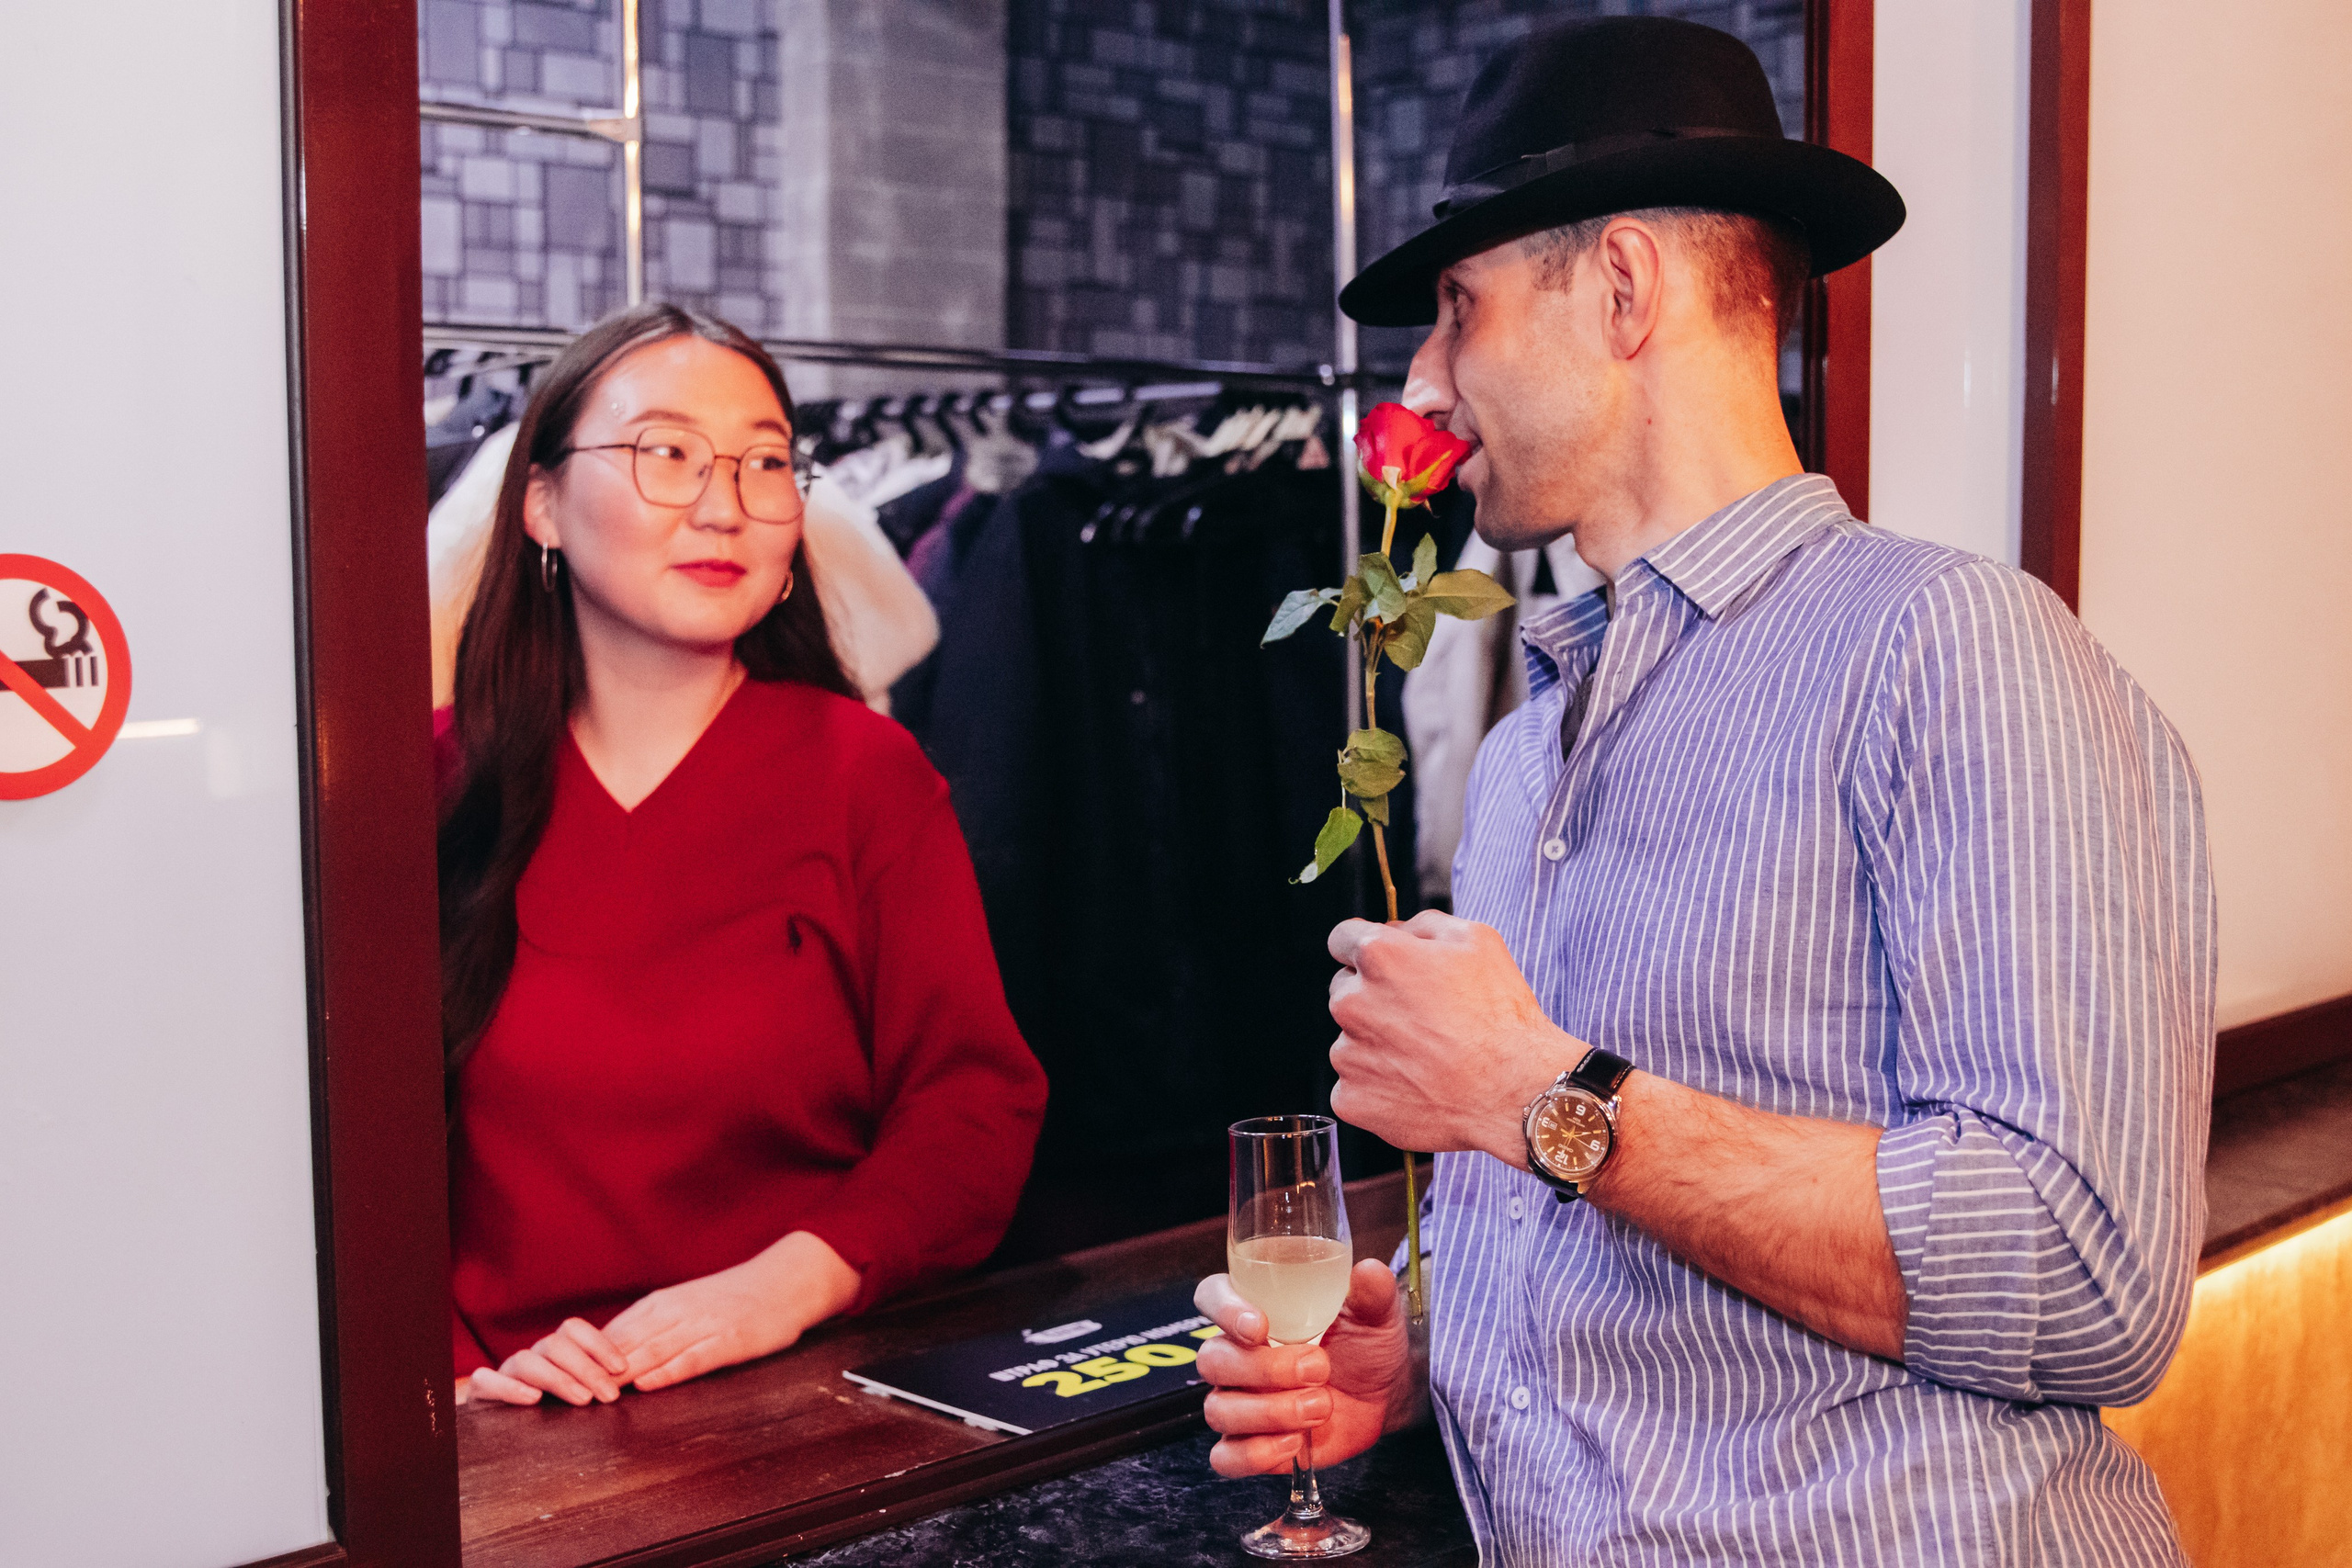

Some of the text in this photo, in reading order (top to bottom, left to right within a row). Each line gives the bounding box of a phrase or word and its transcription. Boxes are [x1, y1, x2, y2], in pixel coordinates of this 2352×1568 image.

[1541, 1116, 1551, 1128] 3
[1555, 1150, 1569, 1166] 12
[988, 1359, 1059, 1382] ШТРАФ
[1054, 1351, 1091, 1364] ЗА
[1022, 1343, 1197, 1398] 250
